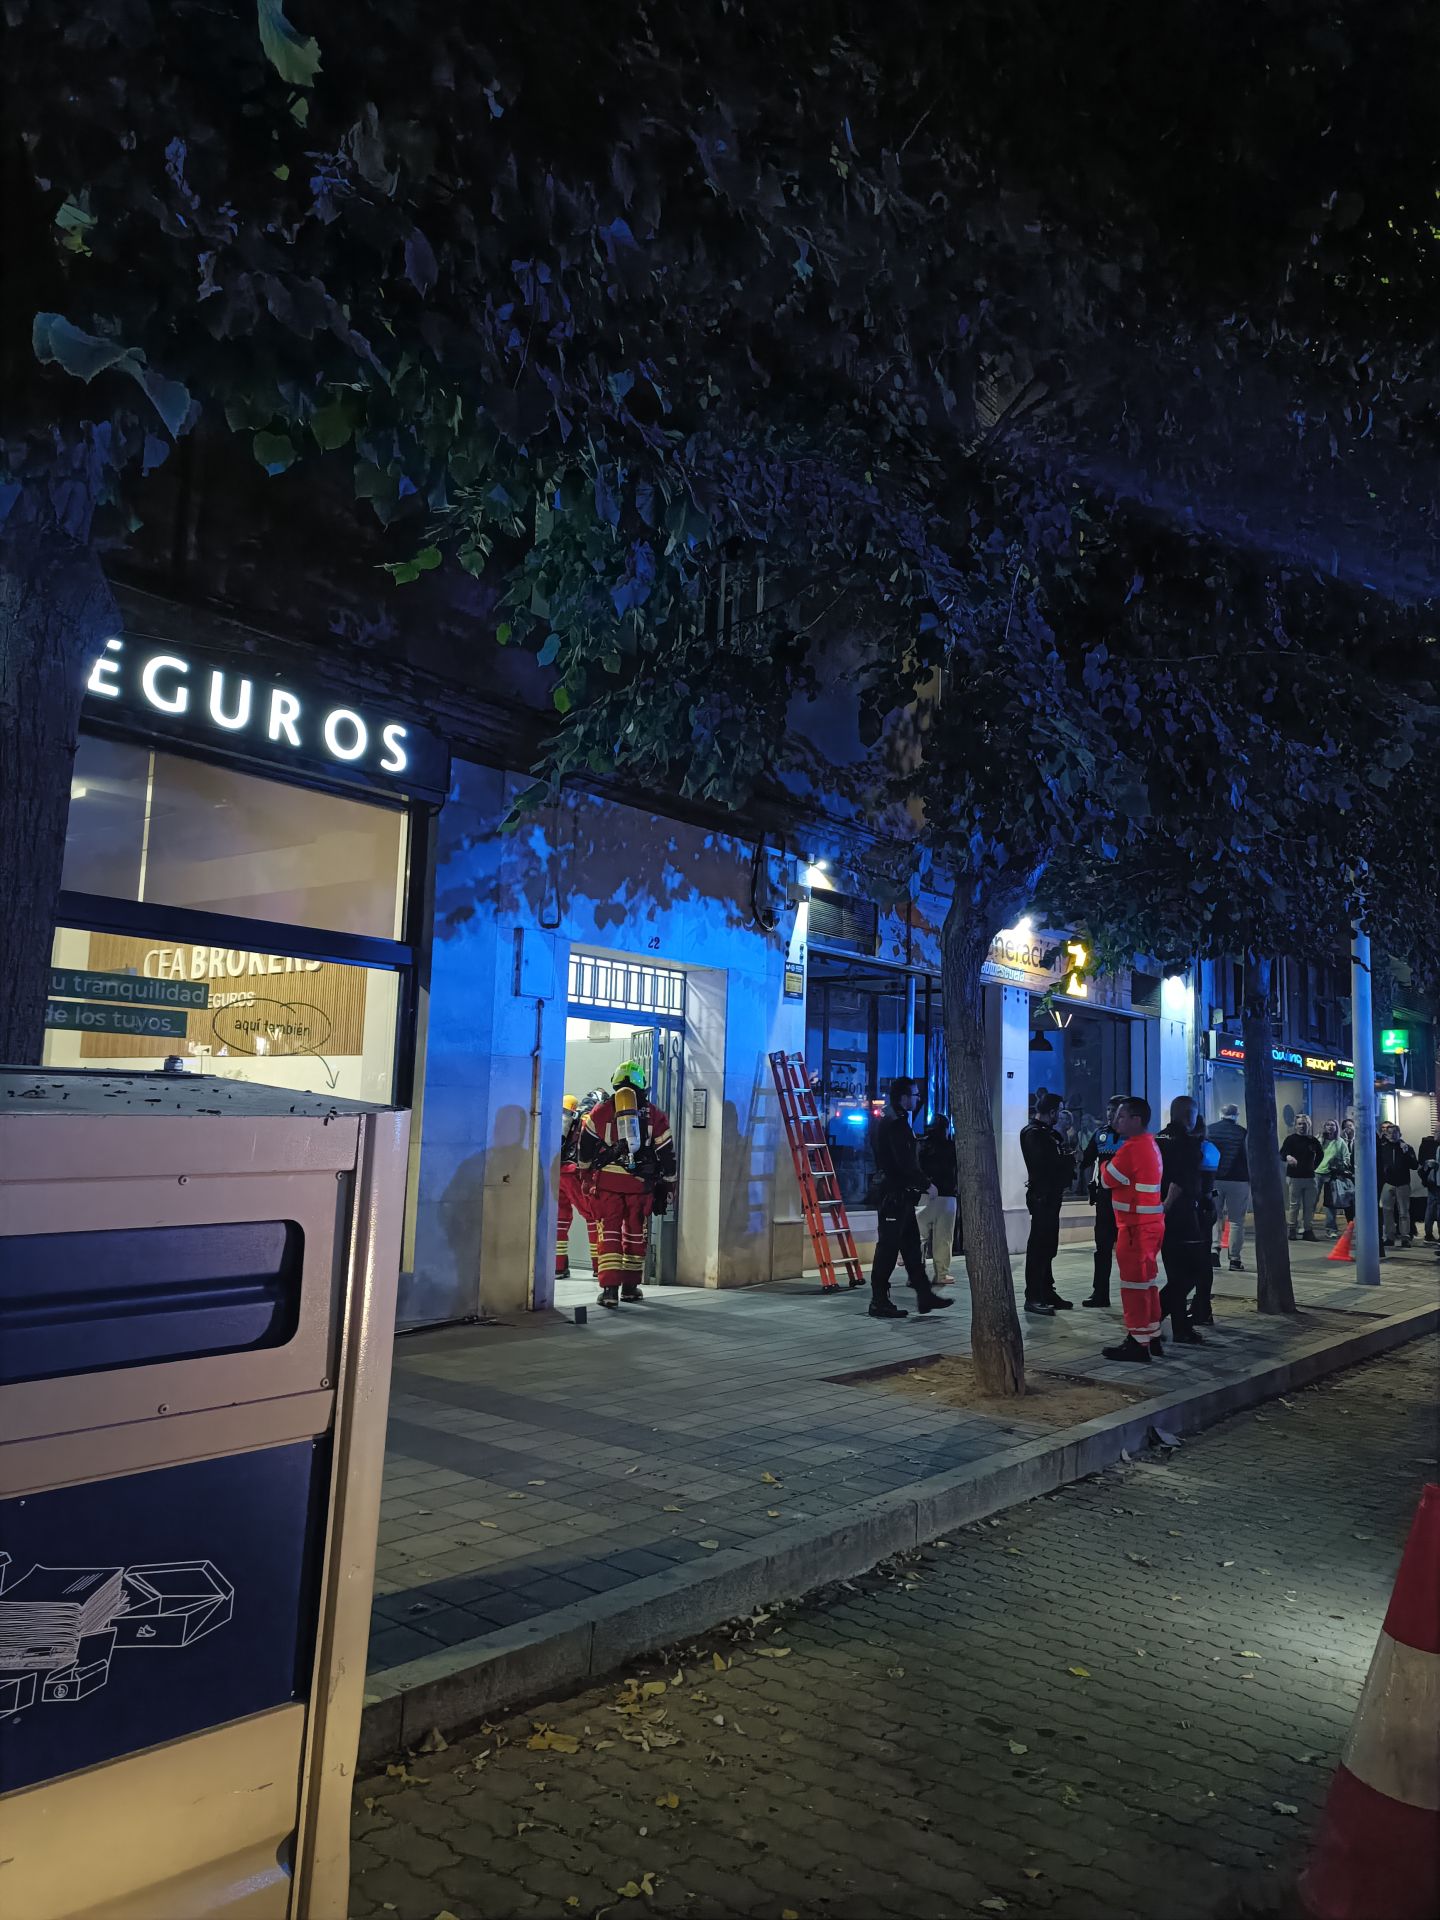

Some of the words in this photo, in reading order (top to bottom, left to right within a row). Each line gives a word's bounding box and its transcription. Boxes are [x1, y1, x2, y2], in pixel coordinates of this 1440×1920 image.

[87, 639, 407, 772] EGUROS
[648, 936, 660, 949] 22
[48, 976, 66, 991] u
[73, 974, 205, 1003] tranquilidad
[75, 1006, 106, 1026] los
[234, 1018, 261, 1036] aquí
[264, 1019, 311, 1037] también
